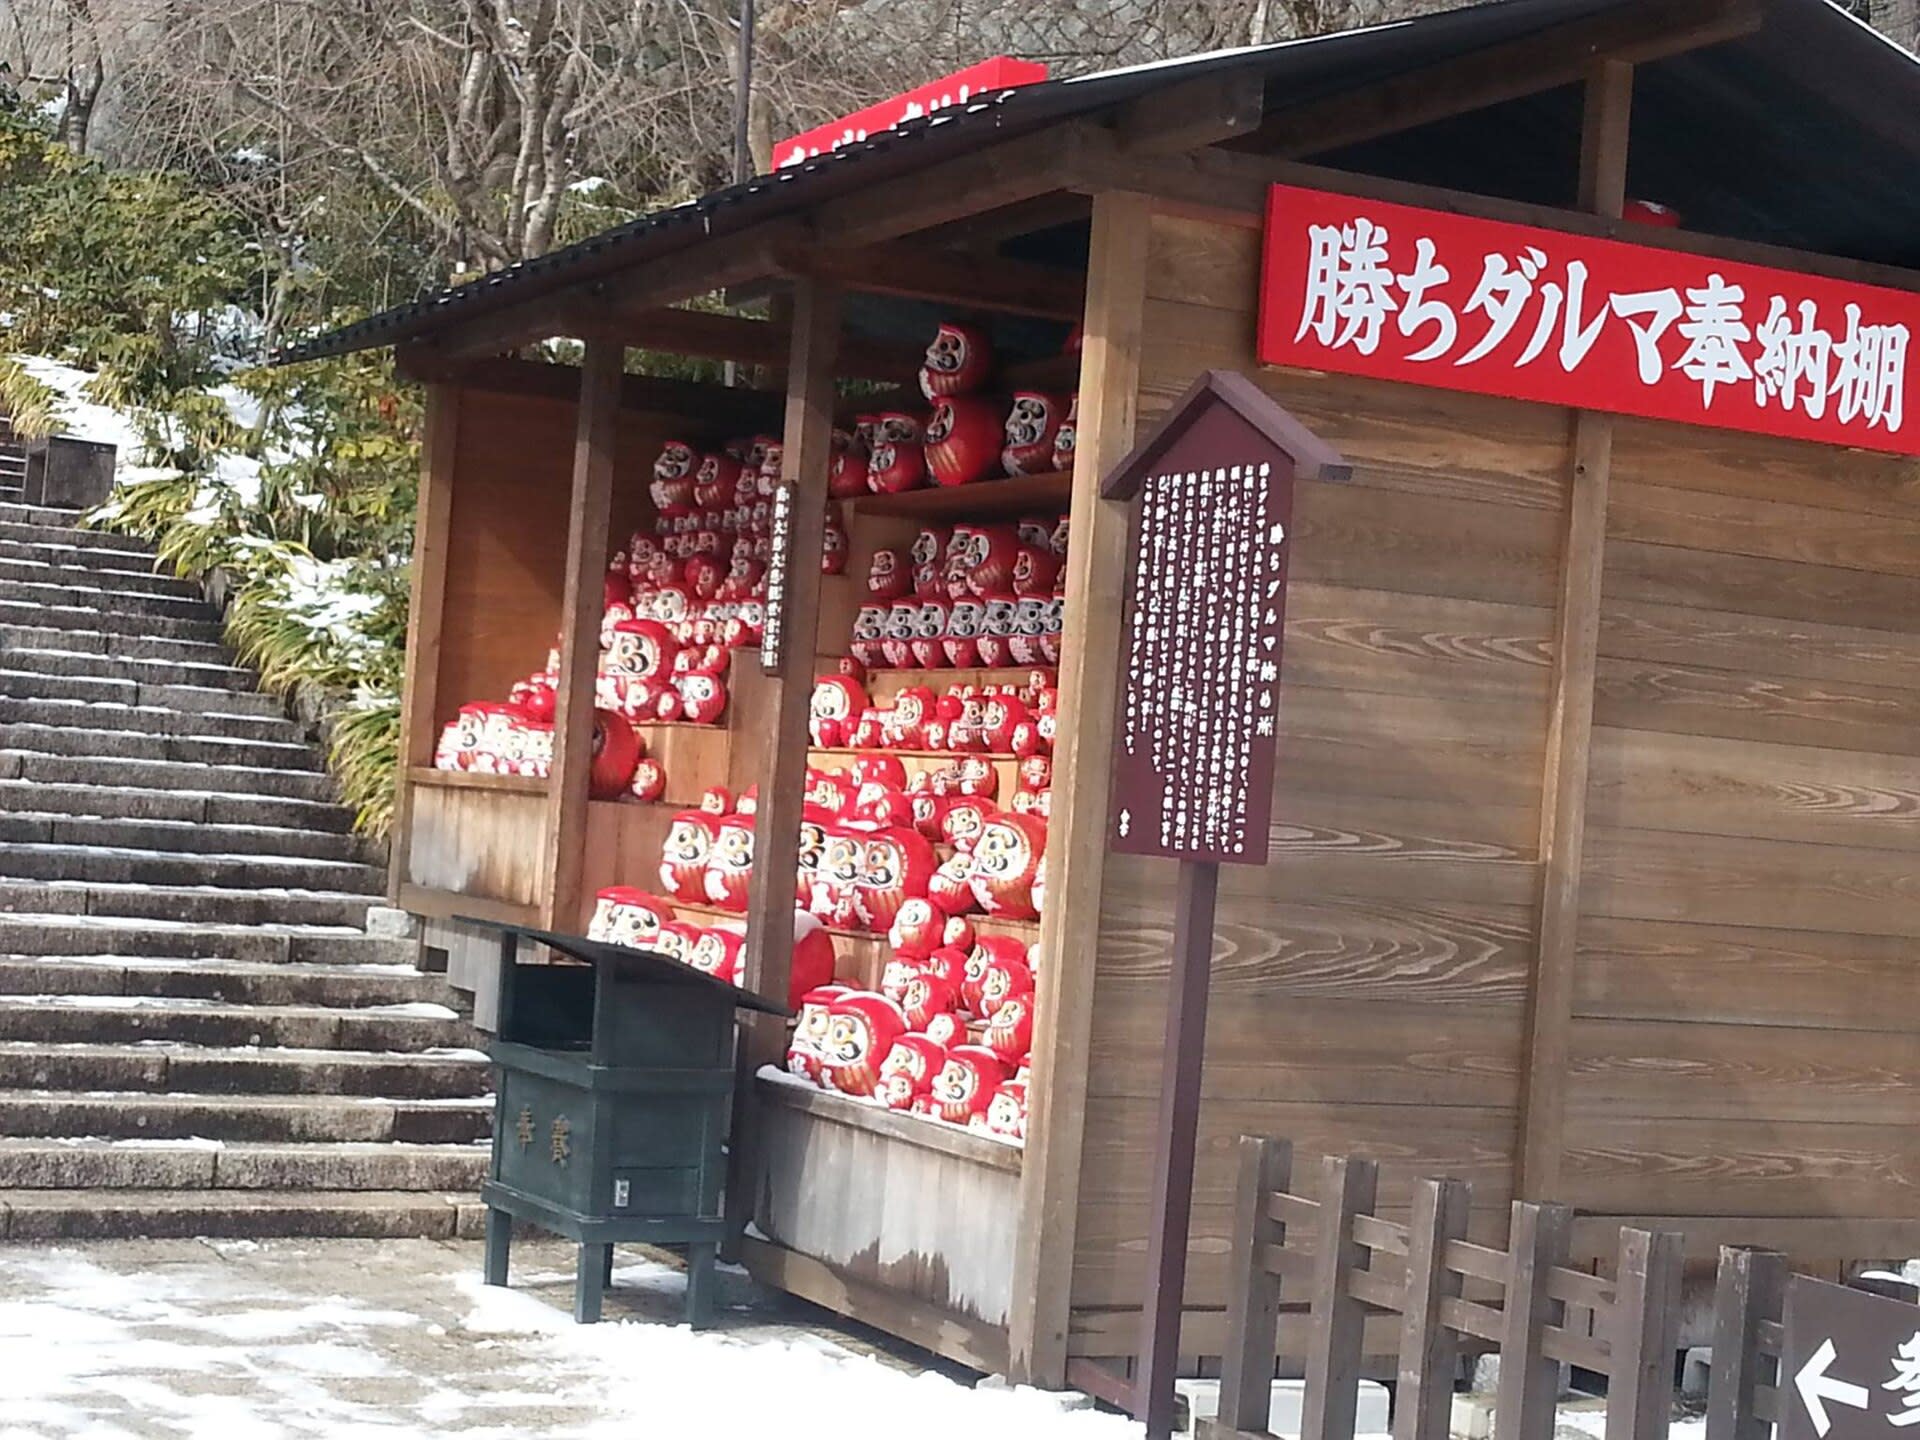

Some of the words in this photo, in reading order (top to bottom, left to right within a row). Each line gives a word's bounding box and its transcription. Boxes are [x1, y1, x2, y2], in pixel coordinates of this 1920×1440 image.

[1295, 218, 1909, 432] 勝ちダルマ奉納棚
